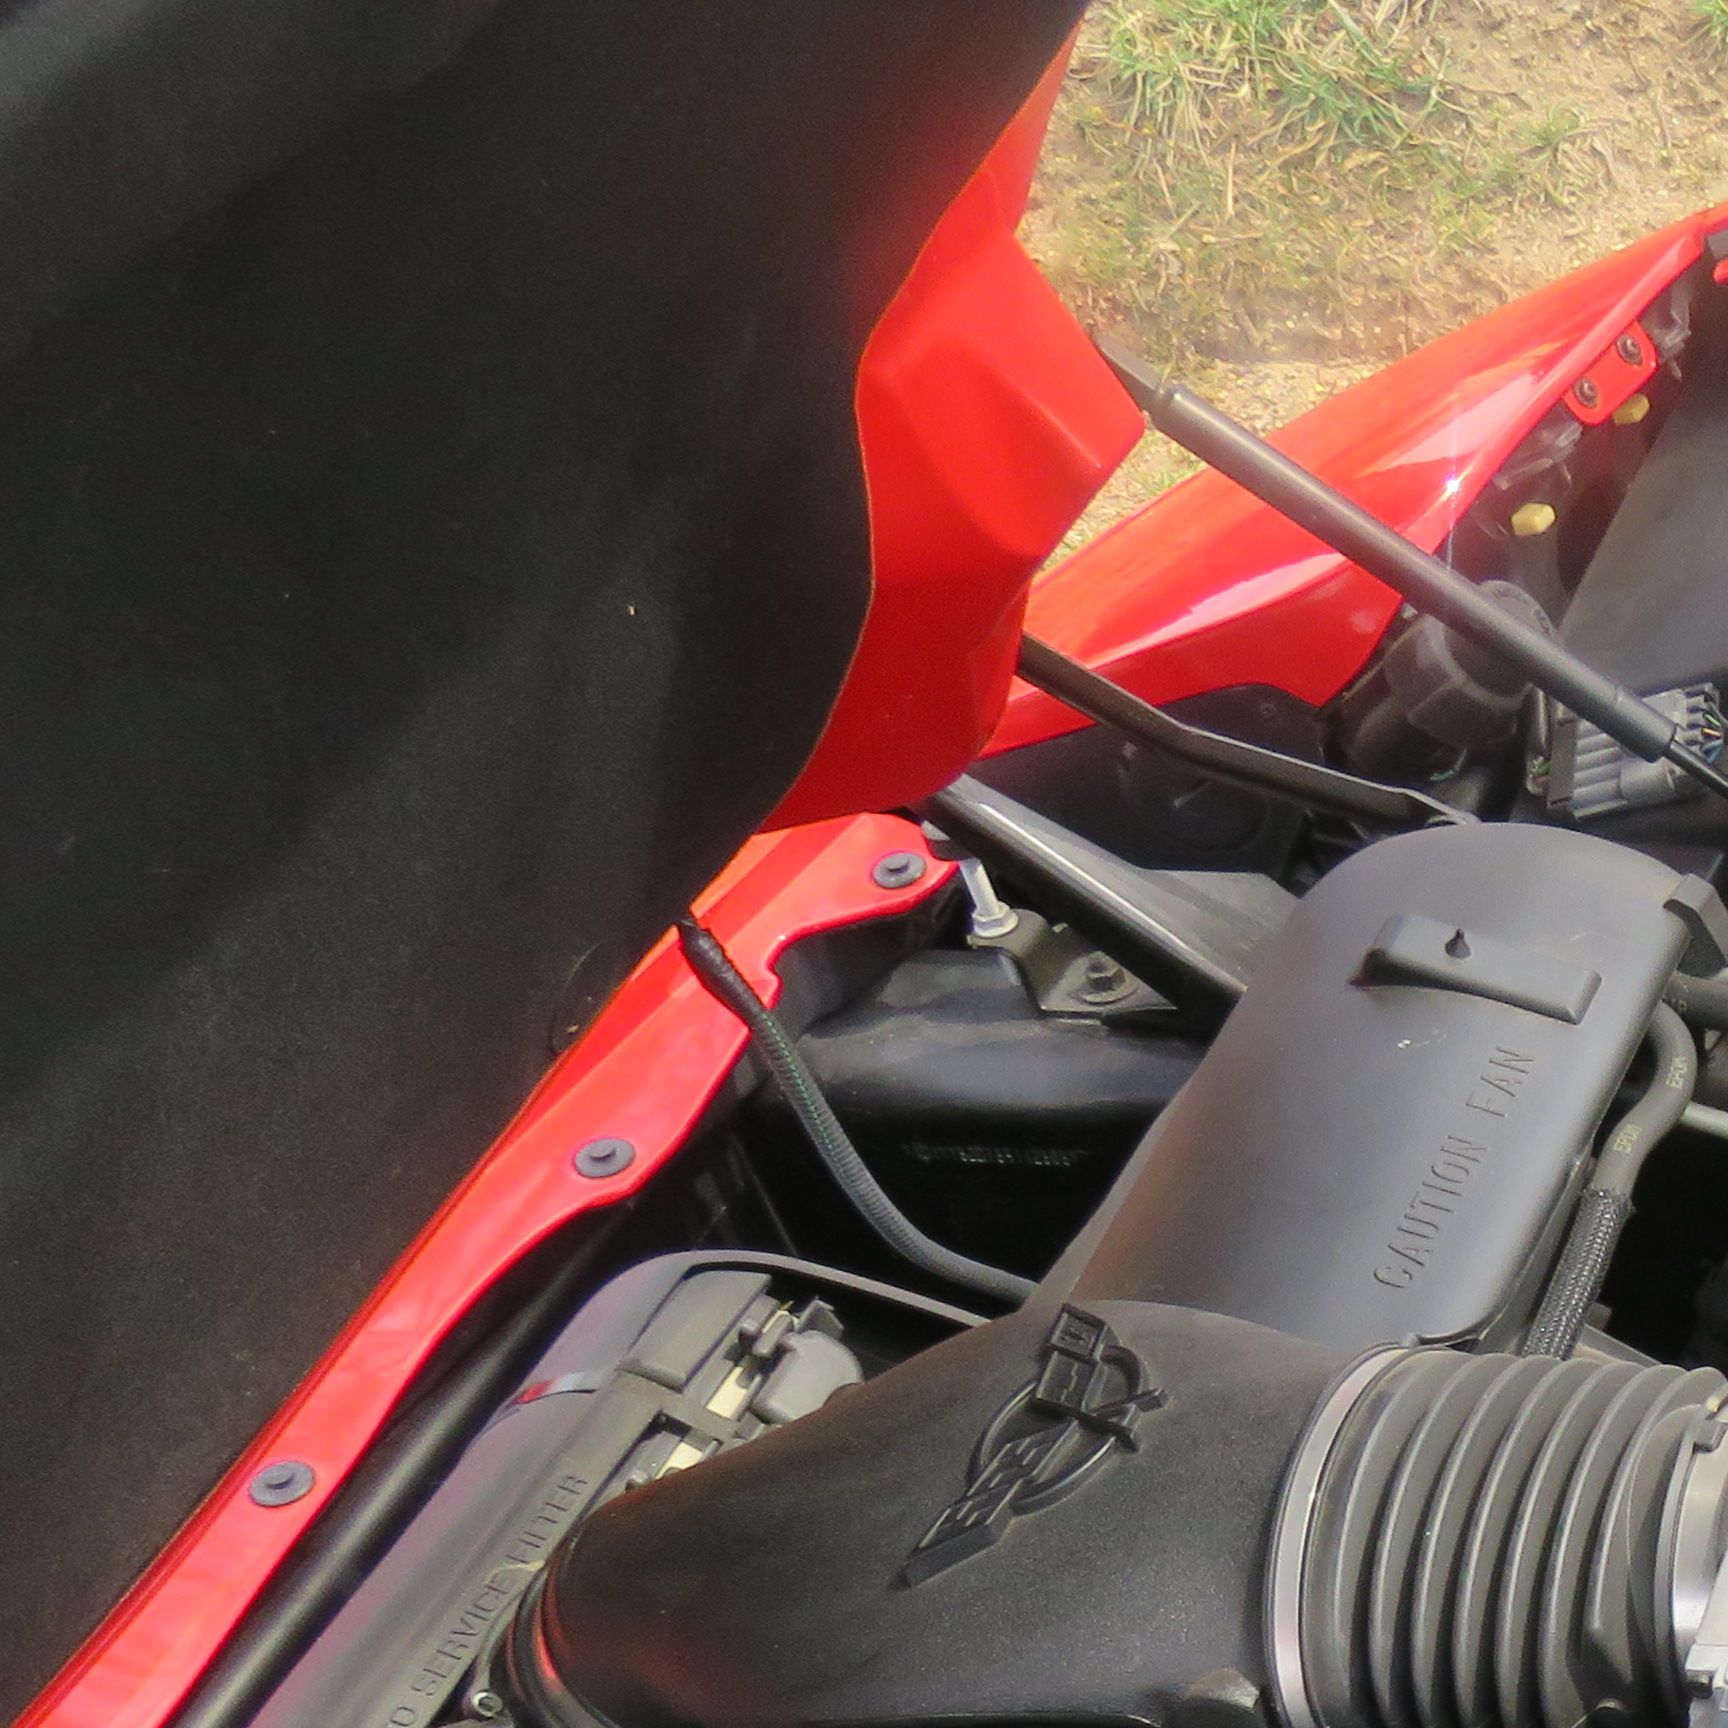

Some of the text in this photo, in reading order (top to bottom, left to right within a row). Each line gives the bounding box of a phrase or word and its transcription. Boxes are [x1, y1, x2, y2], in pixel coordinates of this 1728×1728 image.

[1378, 1045, 1535, 1290] CAUTION FAN
[410, 1570, 510, 1699] SERVICE
[505, 1472, 590, 1567] FILTER
